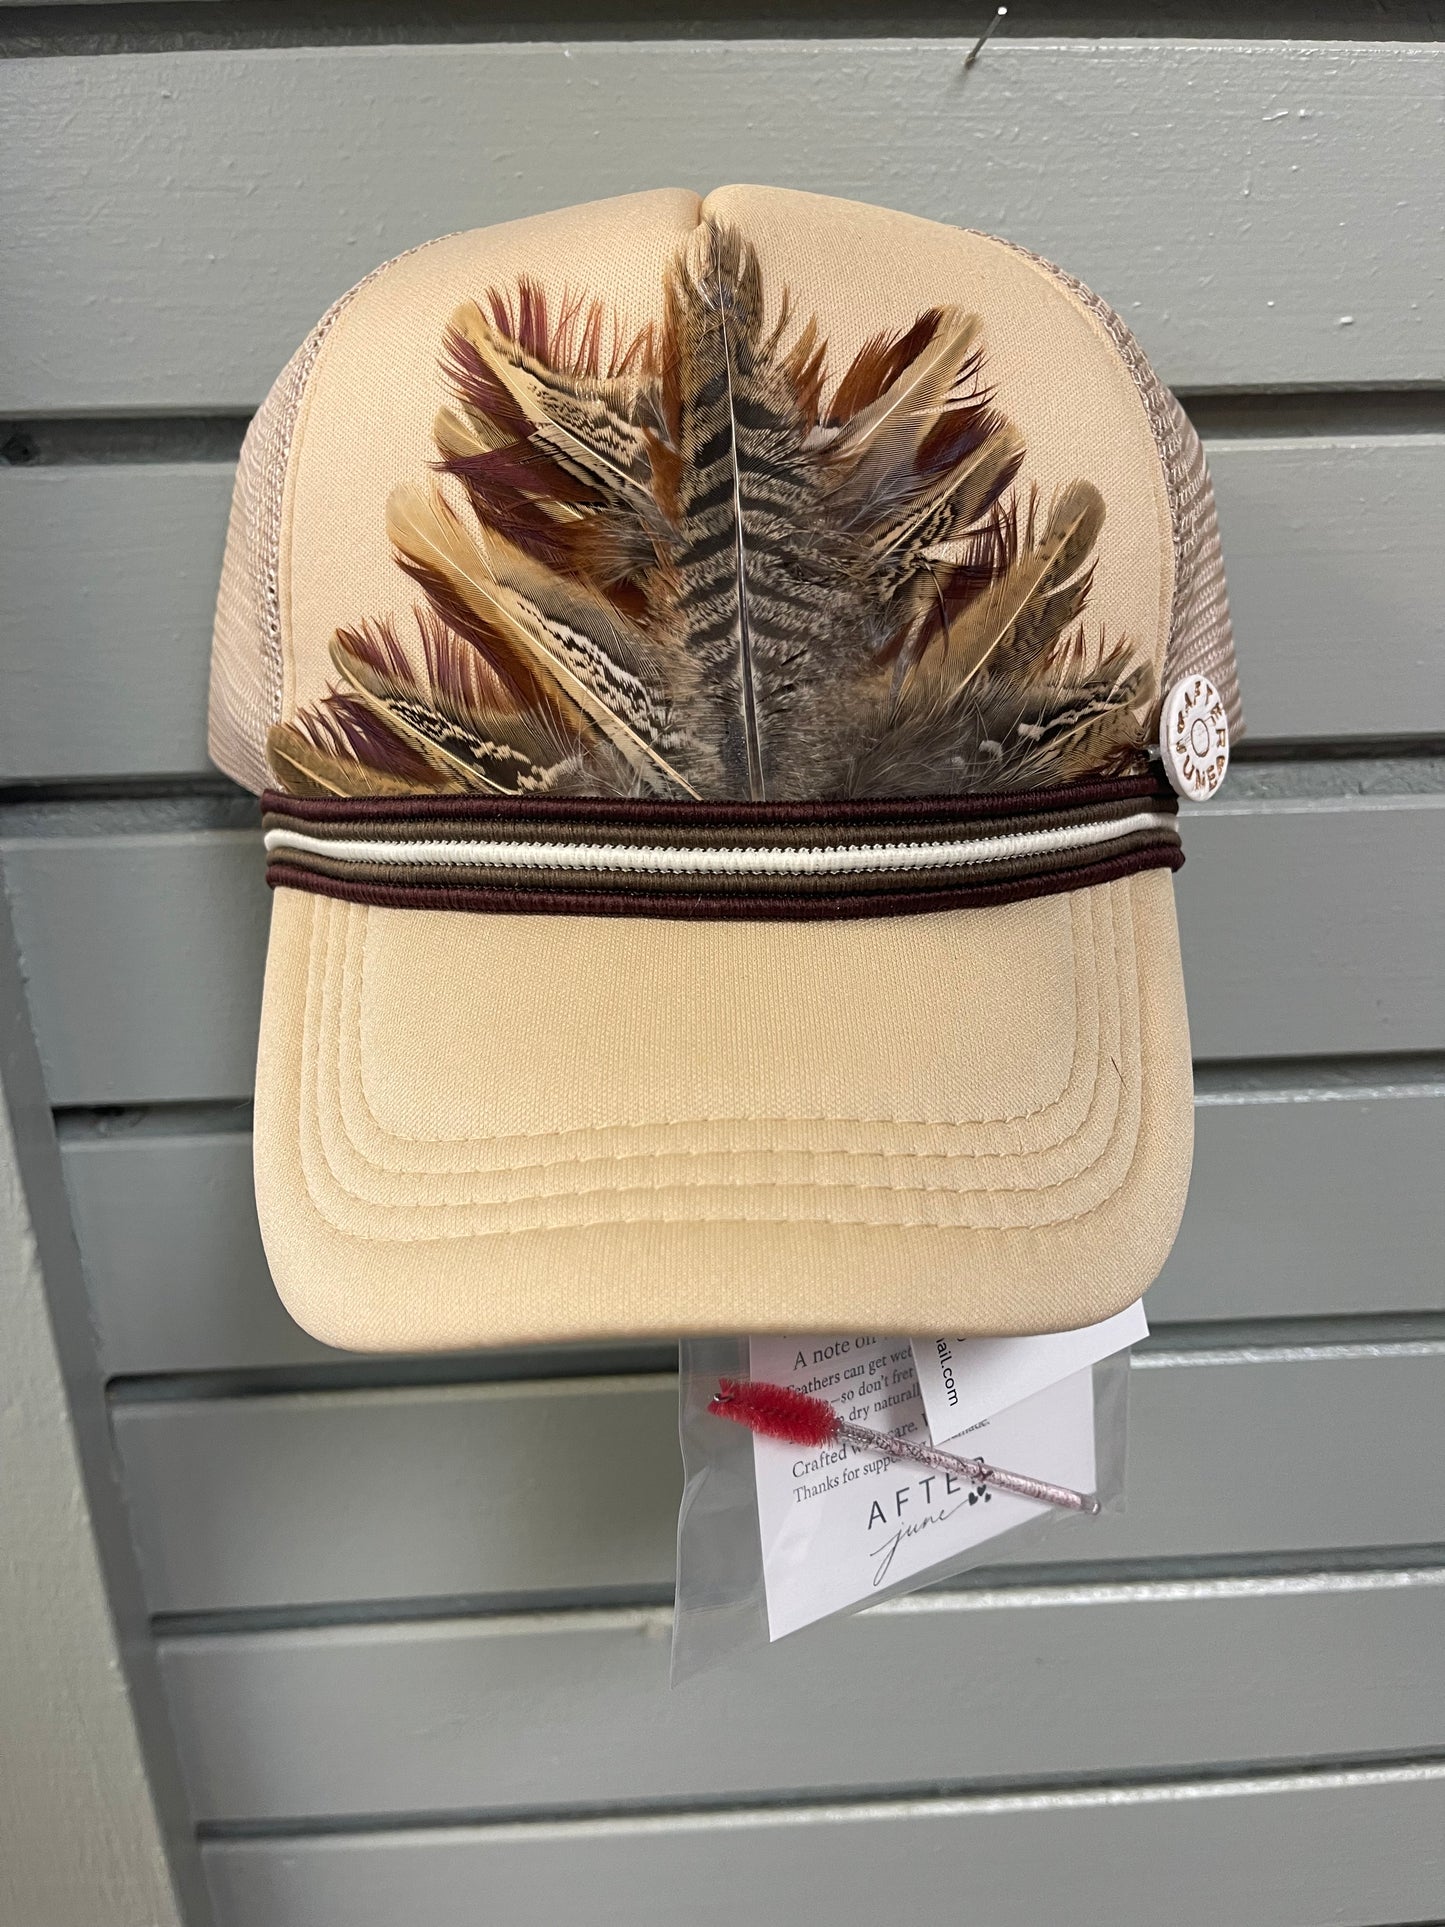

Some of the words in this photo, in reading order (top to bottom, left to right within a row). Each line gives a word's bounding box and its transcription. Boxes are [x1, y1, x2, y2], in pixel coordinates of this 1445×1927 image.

[1184, 680, 1226, 748] AFTER
[793, 1351, 808, 1371] A
[813, 1340, 851, 1364] note
[843, 1364, 866, 1381] can
[868, 1354, 888, 1375] get
[848, 1405, 871, 1422] dry
[873, 1382, 923, 1412] naturall
[858, 1373, 890, 1397] don't
[792, 1443, 848, 1479] Crafted
[793, 1475, 840, 1504] Thanks
[842, 1467, 866, 1485] for
